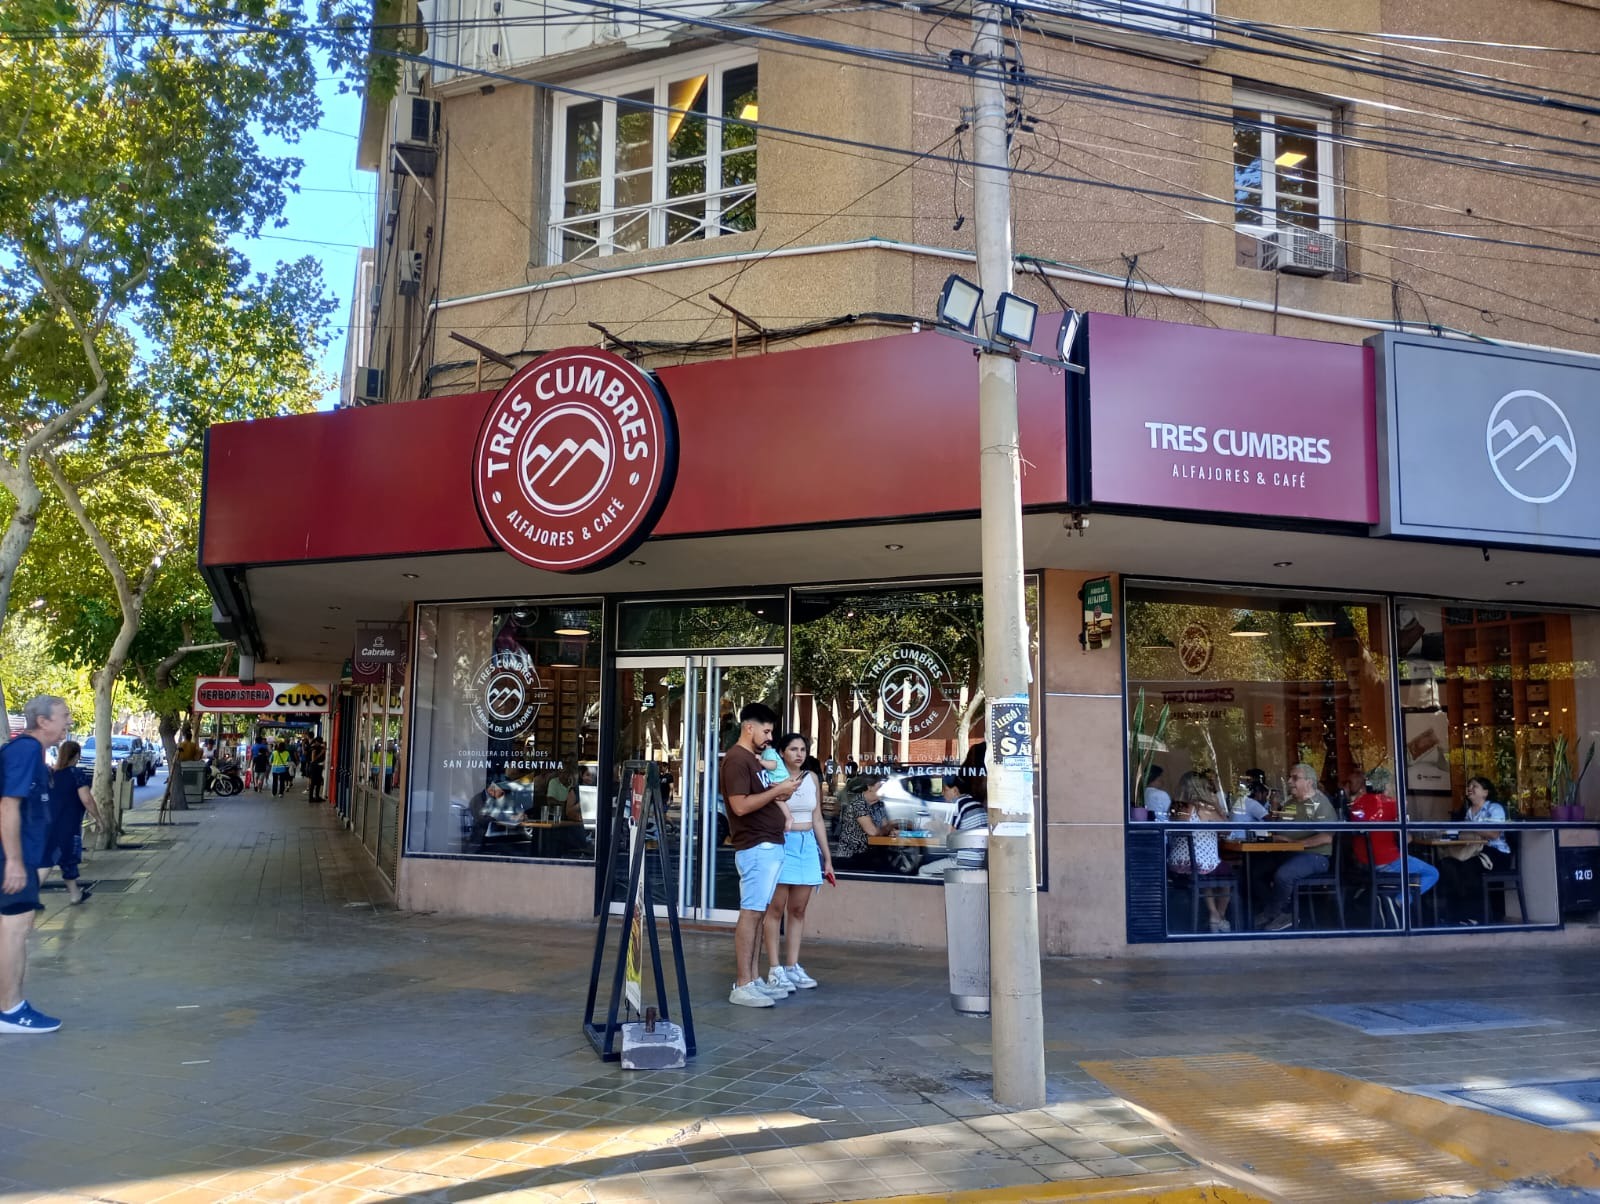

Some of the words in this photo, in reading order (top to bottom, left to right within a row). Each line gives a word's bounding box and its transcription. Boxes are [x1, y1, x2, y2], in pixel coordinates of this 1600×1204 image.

[488, 393, 532, 478] TRES
[535, 366, 648, 461] CUMBRES
[1145, 422, 1208, 453] TRES
[1213, 429, 1332, 465] CUMBRES
[1172, 463, 1250, 484] ALFAJORES
[1256, 471, 1266, 485] &
[1273, 471, 1306, 488] CAFÉ
[506, 509, 574, 546] ALFAJORES
[582, 526, 592, 541] &
[593, 496, 625, 532] CAFÉ
[361, 647, 395, 657] Cabrales
[868, 654, 891, 679] TRES
[892, 648, 943, 679] CUMBRES
[477, 663, 496, 685] TRES
[275, 693, 327, 708] CUYO
[443, 759, 462, 769] SAN
[466, 760, 492, 769] JUAN
[503, 760, 564, 770] ARGENTINA
[826, 765, 852, 775] SAN
[858, 765, 891, 775] JUAN
[907, 766, 987, 777] ARGENTINA
